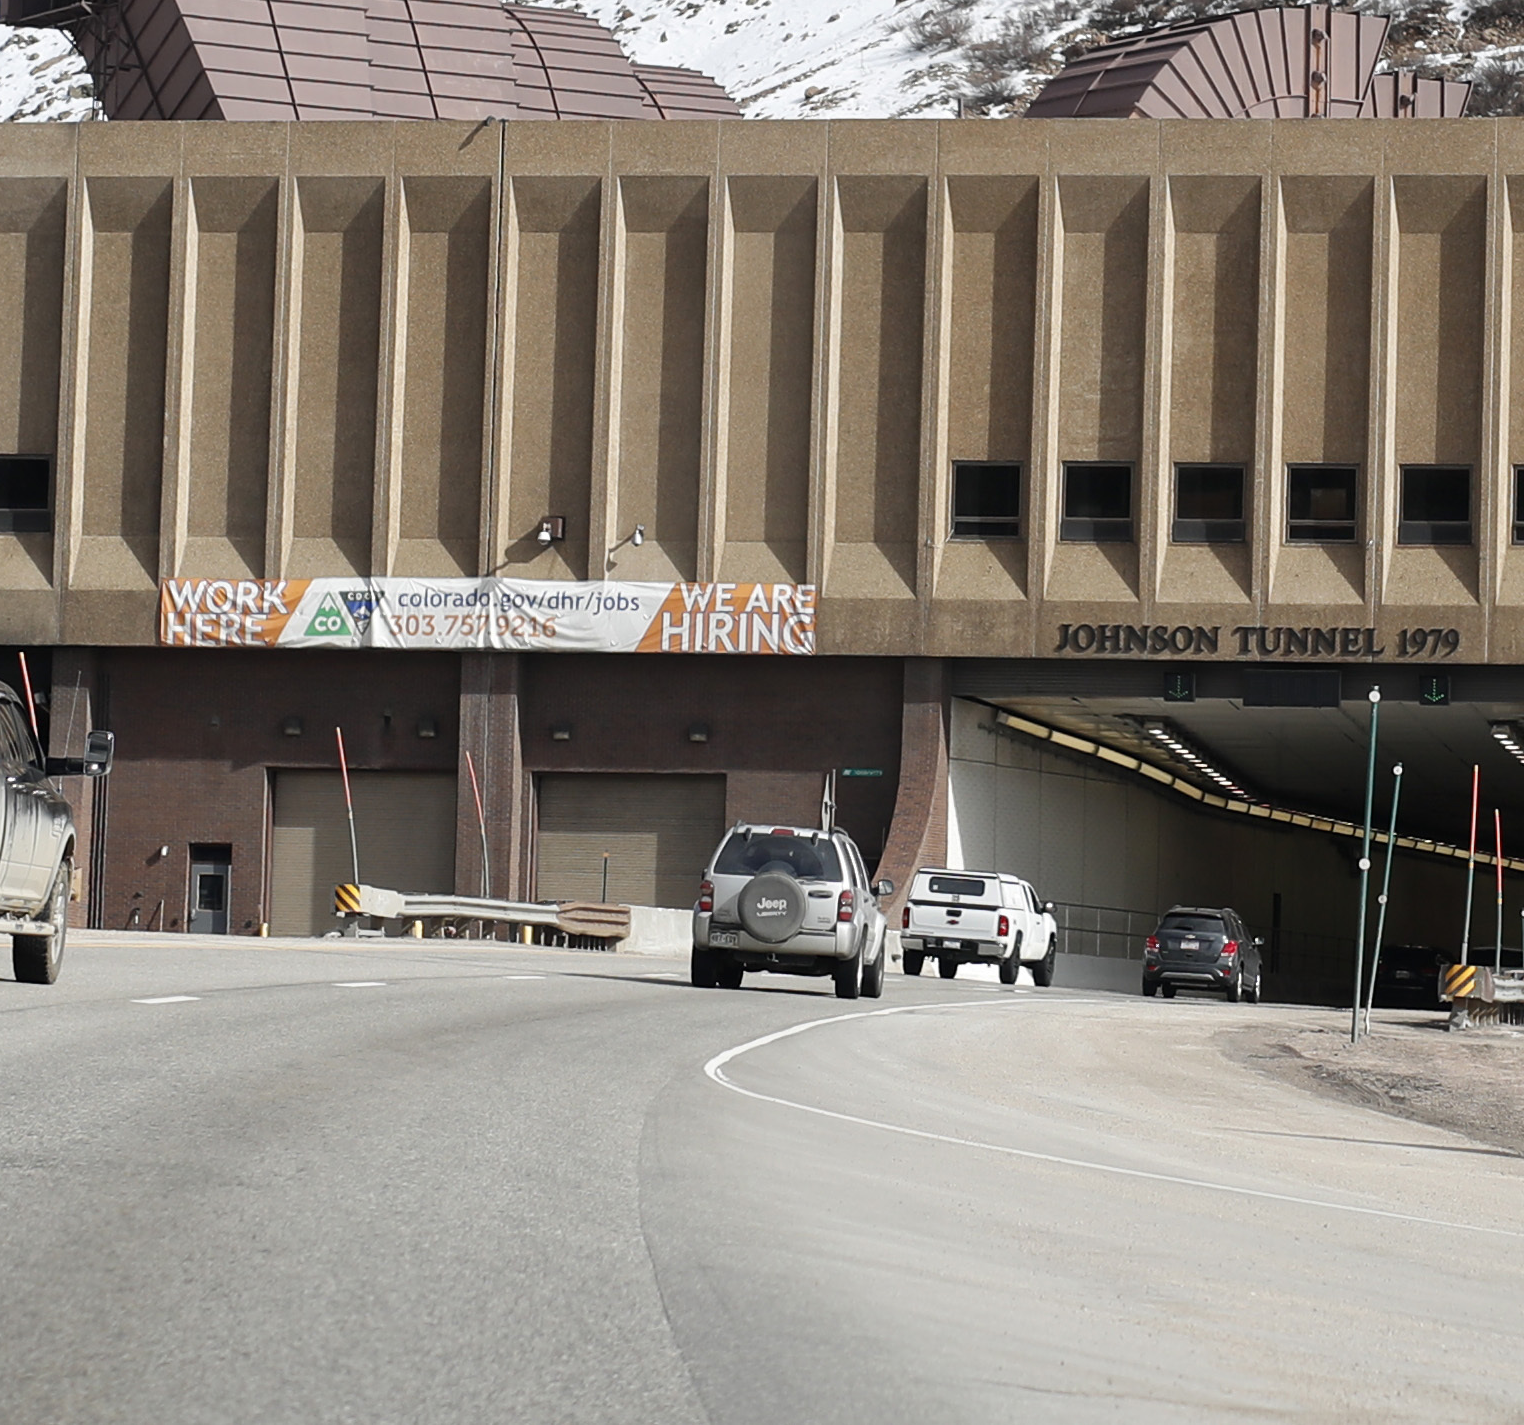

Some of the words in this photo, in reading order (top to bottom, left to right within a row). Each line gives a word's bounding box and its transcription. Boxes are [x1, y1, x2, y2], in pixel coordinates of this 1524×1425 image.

[168, 579, 290, 614] WORK
[398, 586, 640, 616] colorado.gov/dhr/jobs
[679, 582, 736, 612] WE
[744, 582, 816, 614] ARE
[167, 613, 268, 646] HERE
[314, 616, 342, 632] CO
[389, 613, 558, 638] 303.757.9216
[661, 612, 816, 655] HIRING
[1055, 624, 1221, 656] JOHNSON
[1231, 625, 1386, 657] TUNNEL
[1395, 627, 1460, 658] 1979
[756, 897, 788, 911] Jeep
